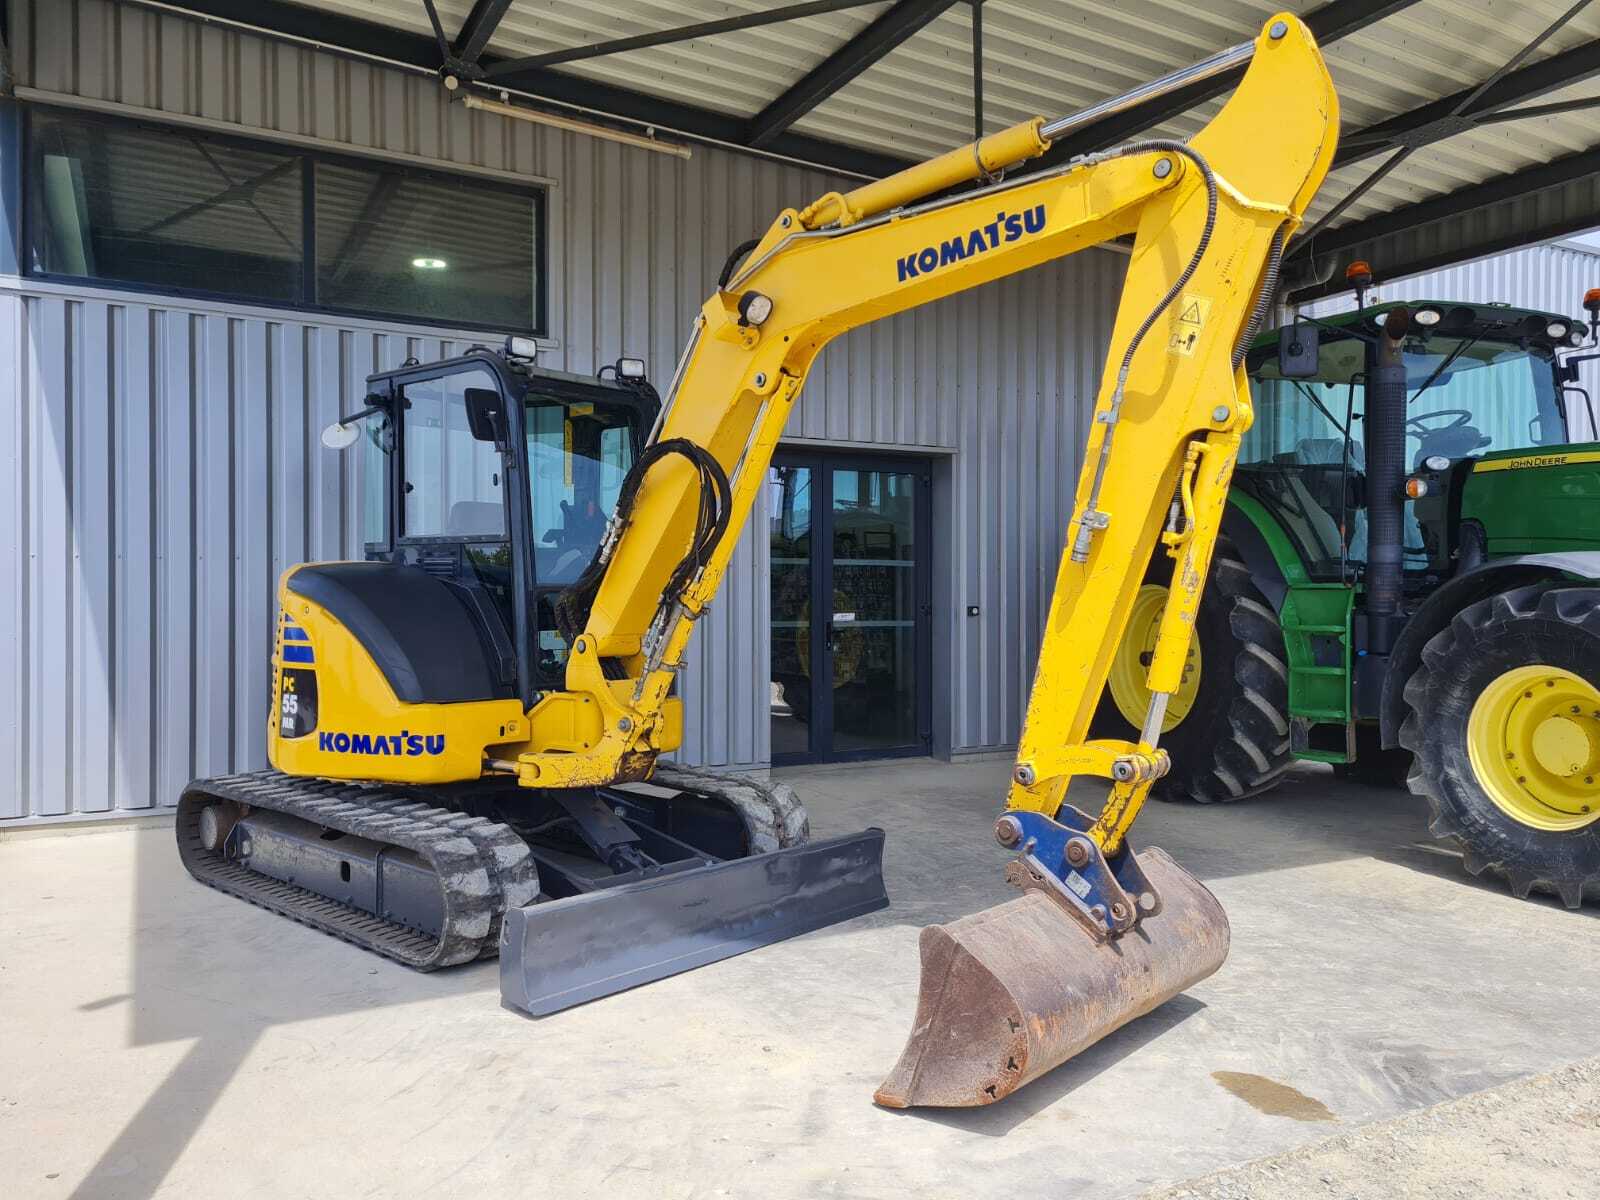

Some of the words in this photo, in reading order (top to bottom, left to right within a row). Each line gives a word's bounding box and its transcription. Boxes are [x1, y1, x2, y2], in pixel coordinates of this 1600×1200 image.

[897, 204, 1046, 282] KOMATSU
[1509, 459, 1532, 469] JOHN
[1534, 456, 1568, 465] DEERE
[283, 676, 295, 692] PC
[282, 693, 298, 714] 55
[319, 730, 445, 756] KOMATSU
